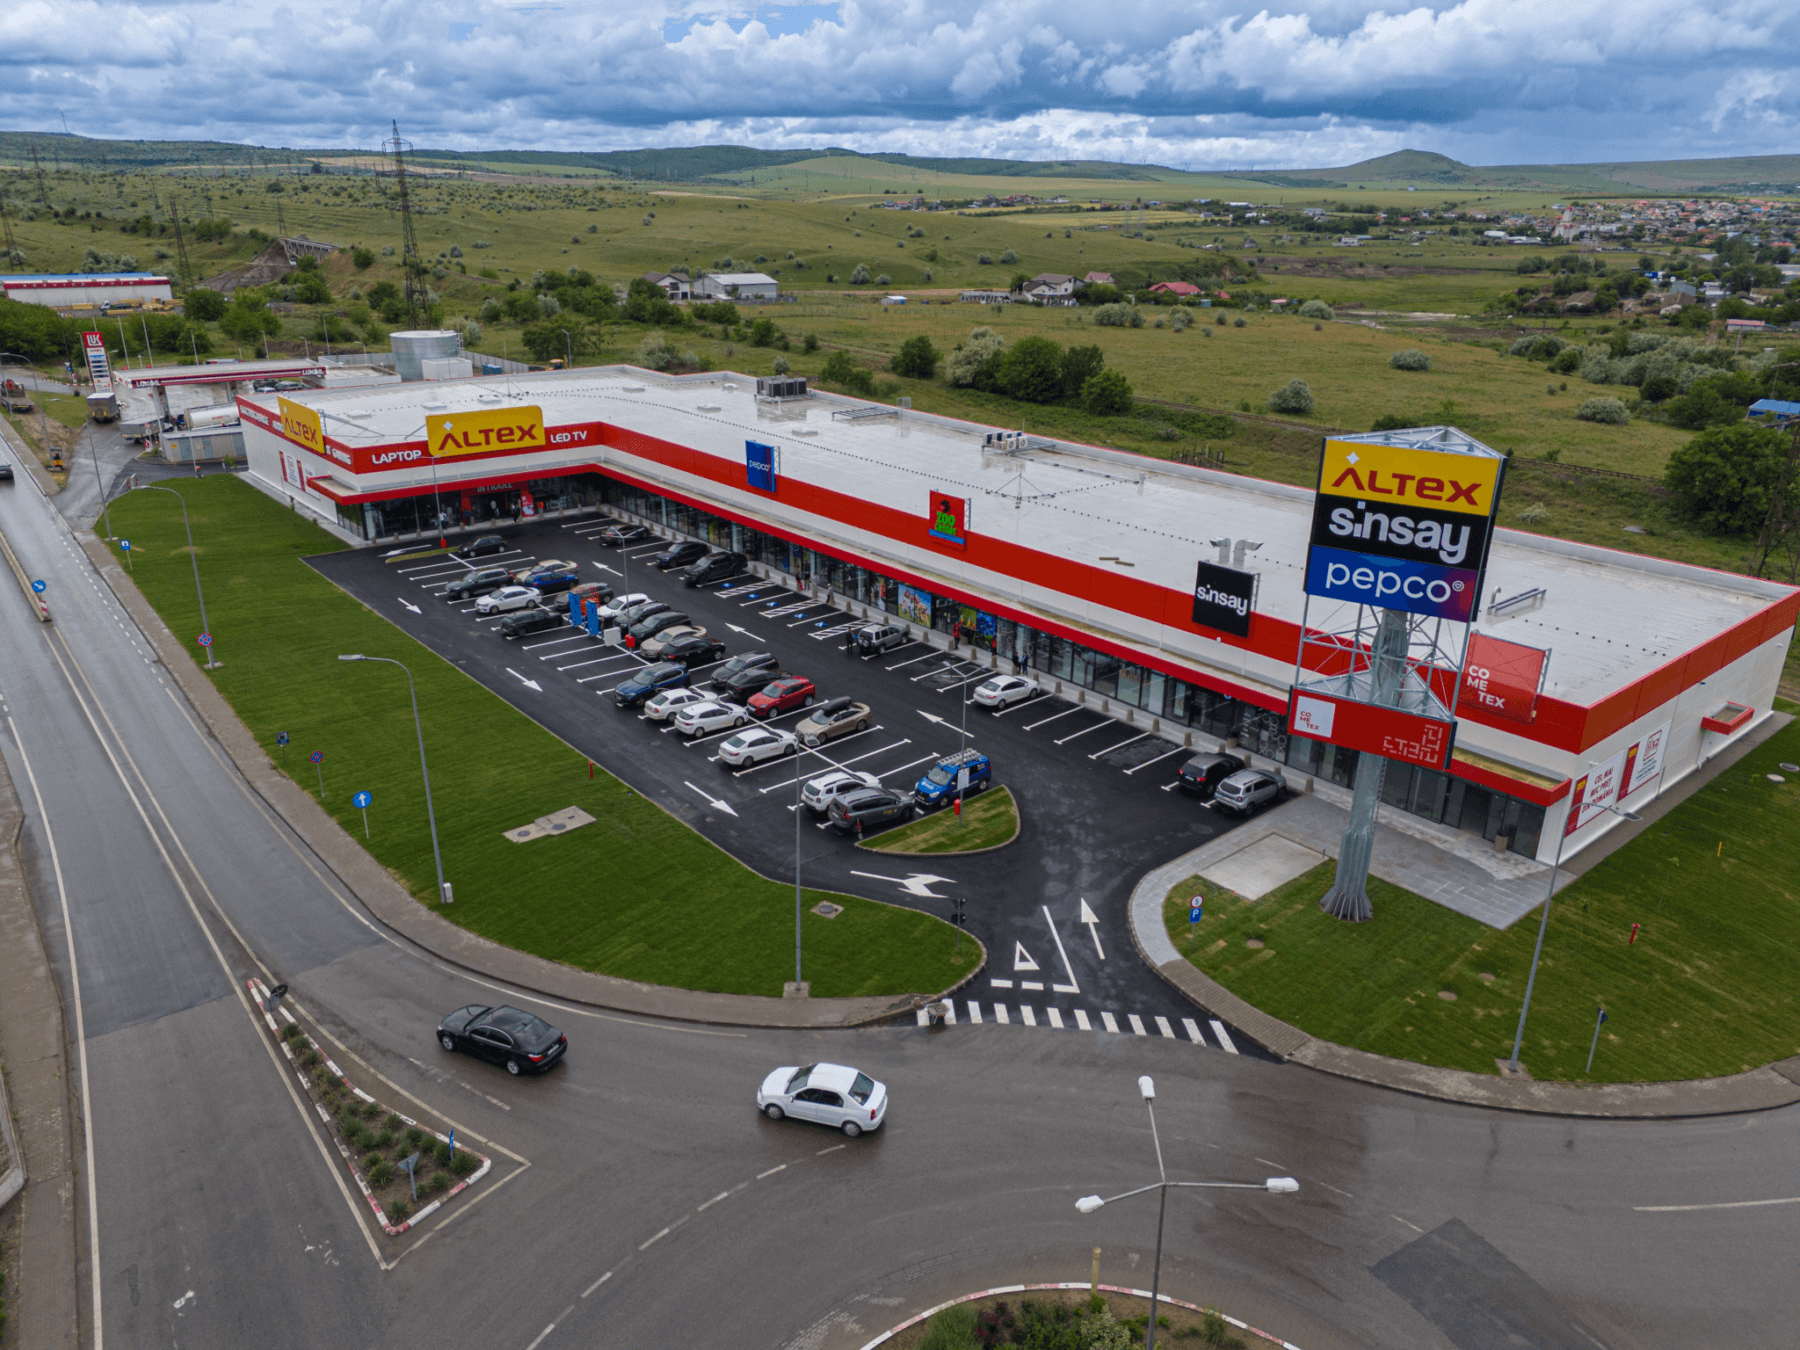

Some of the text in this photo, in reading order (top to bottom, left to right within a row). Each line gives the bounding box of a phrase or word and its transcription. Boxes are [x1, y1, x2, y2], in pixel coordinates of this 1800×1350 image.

[550, 430, 588, 444] LED TV
[371, 449, 422, 465] LAPTOP
[748, 459, 769, 472] pepco
[1328, 500, 1471, 565] sinsay
[1325, 562, 1451, 603] pepco
[1196, 583, 1248, 616] sinsay
[1478, 691, 1505, 709] TEX
